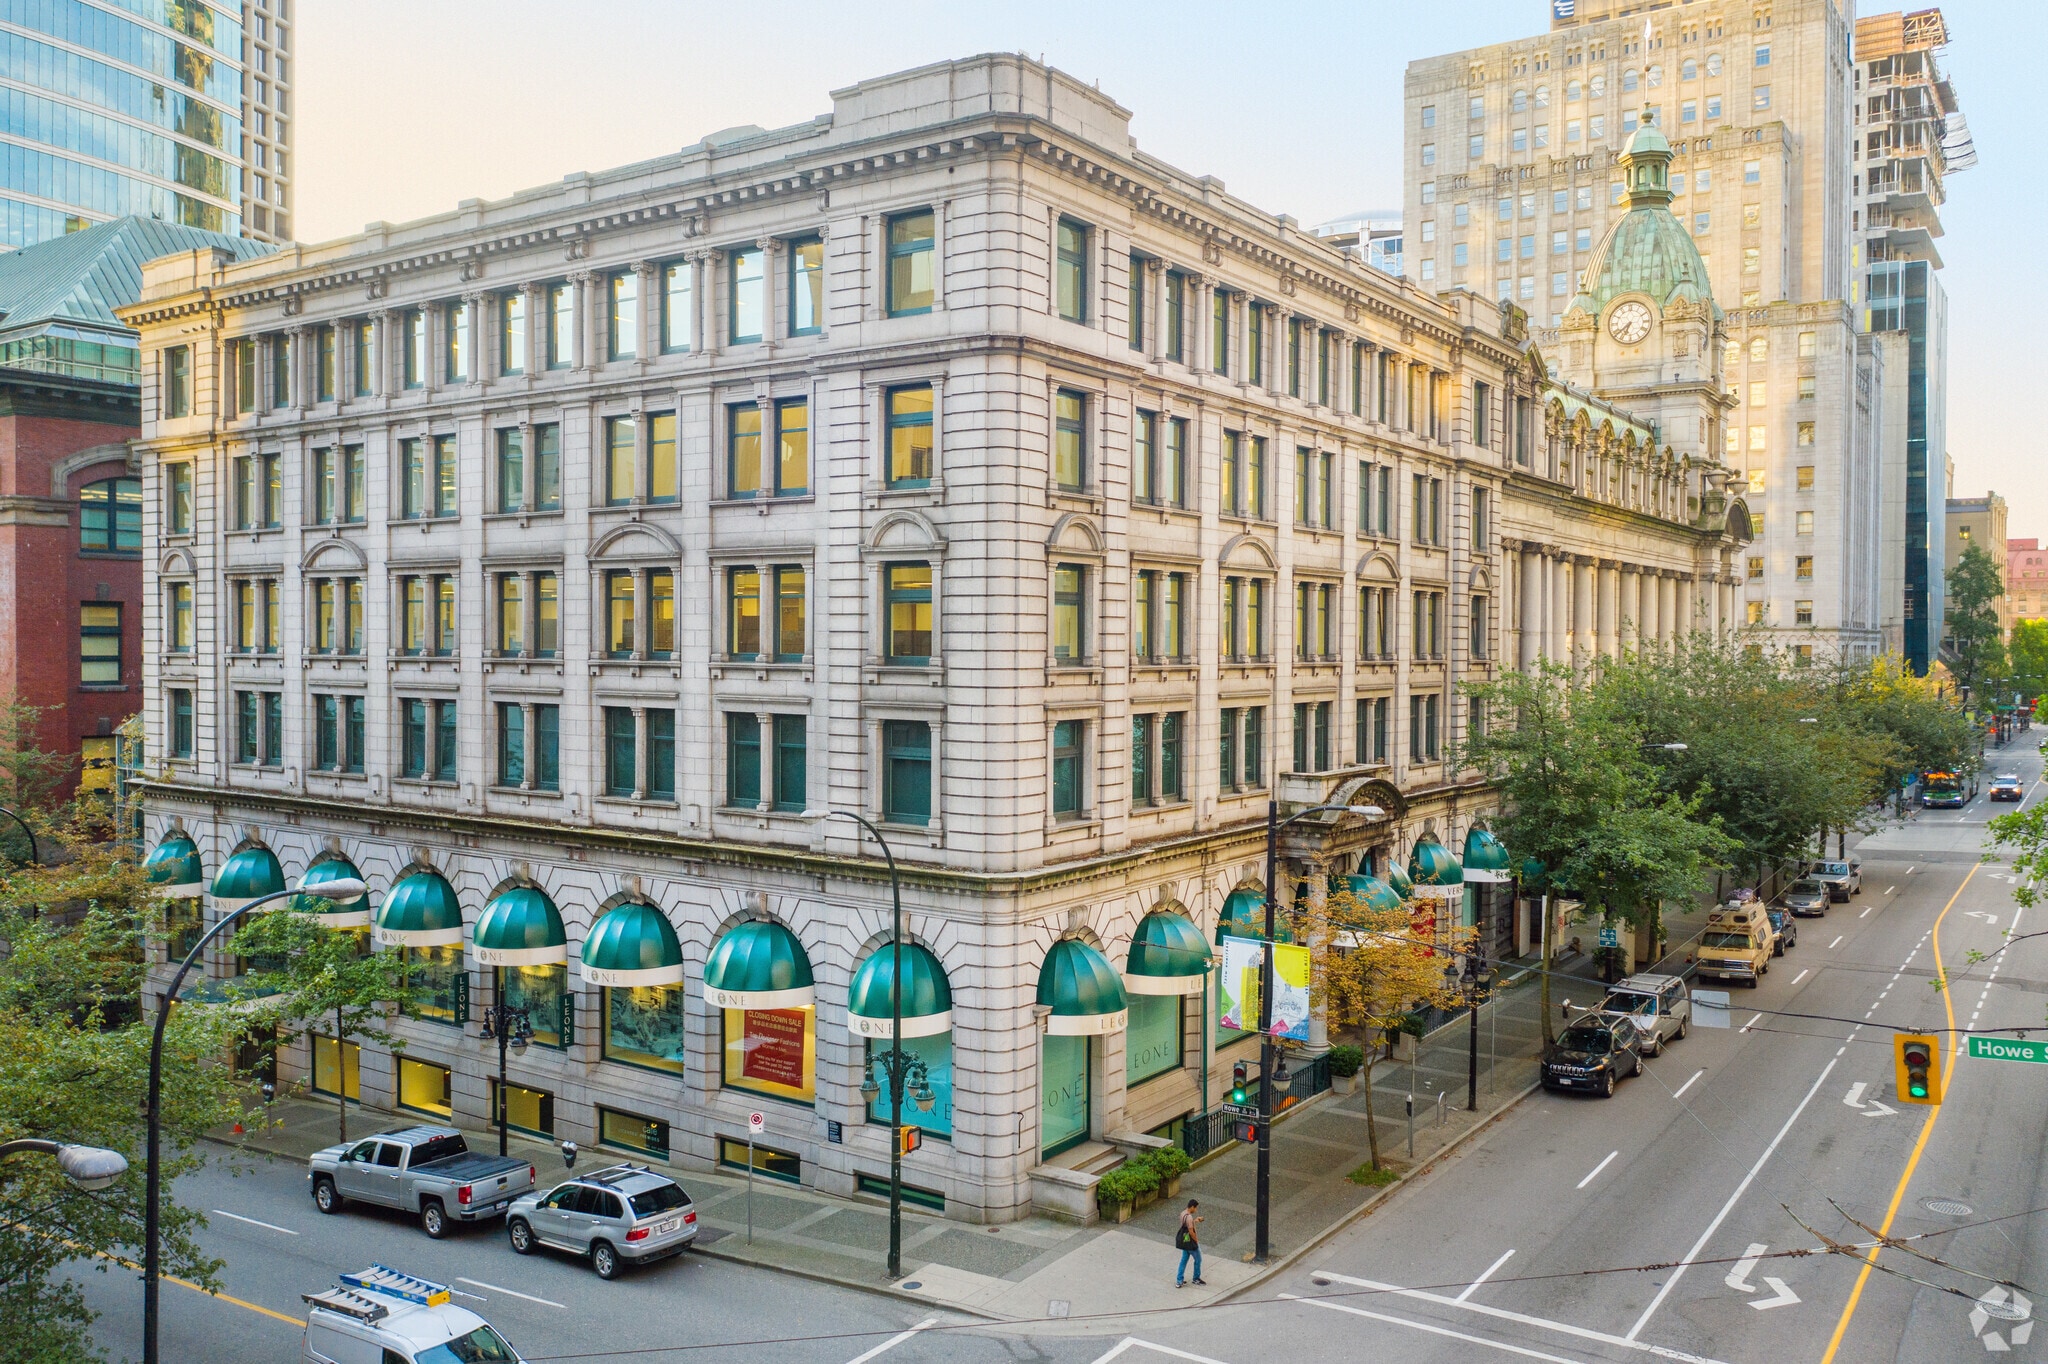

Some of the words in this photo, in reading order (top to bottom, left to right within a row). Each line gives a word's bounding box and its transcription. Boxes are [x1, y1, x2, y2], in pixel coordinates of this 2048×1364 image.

[748, 1010, 770, 1021] CLOSING
[771, 1014, 788, 1024] DOWN
[788, 1018, 802, 1027] SALE
[1128, 1041, 1169, 1071] EONE
[1977, 1040, 2035, 1059] Howe
[1223, 1104, 1240, 1113] Howe
